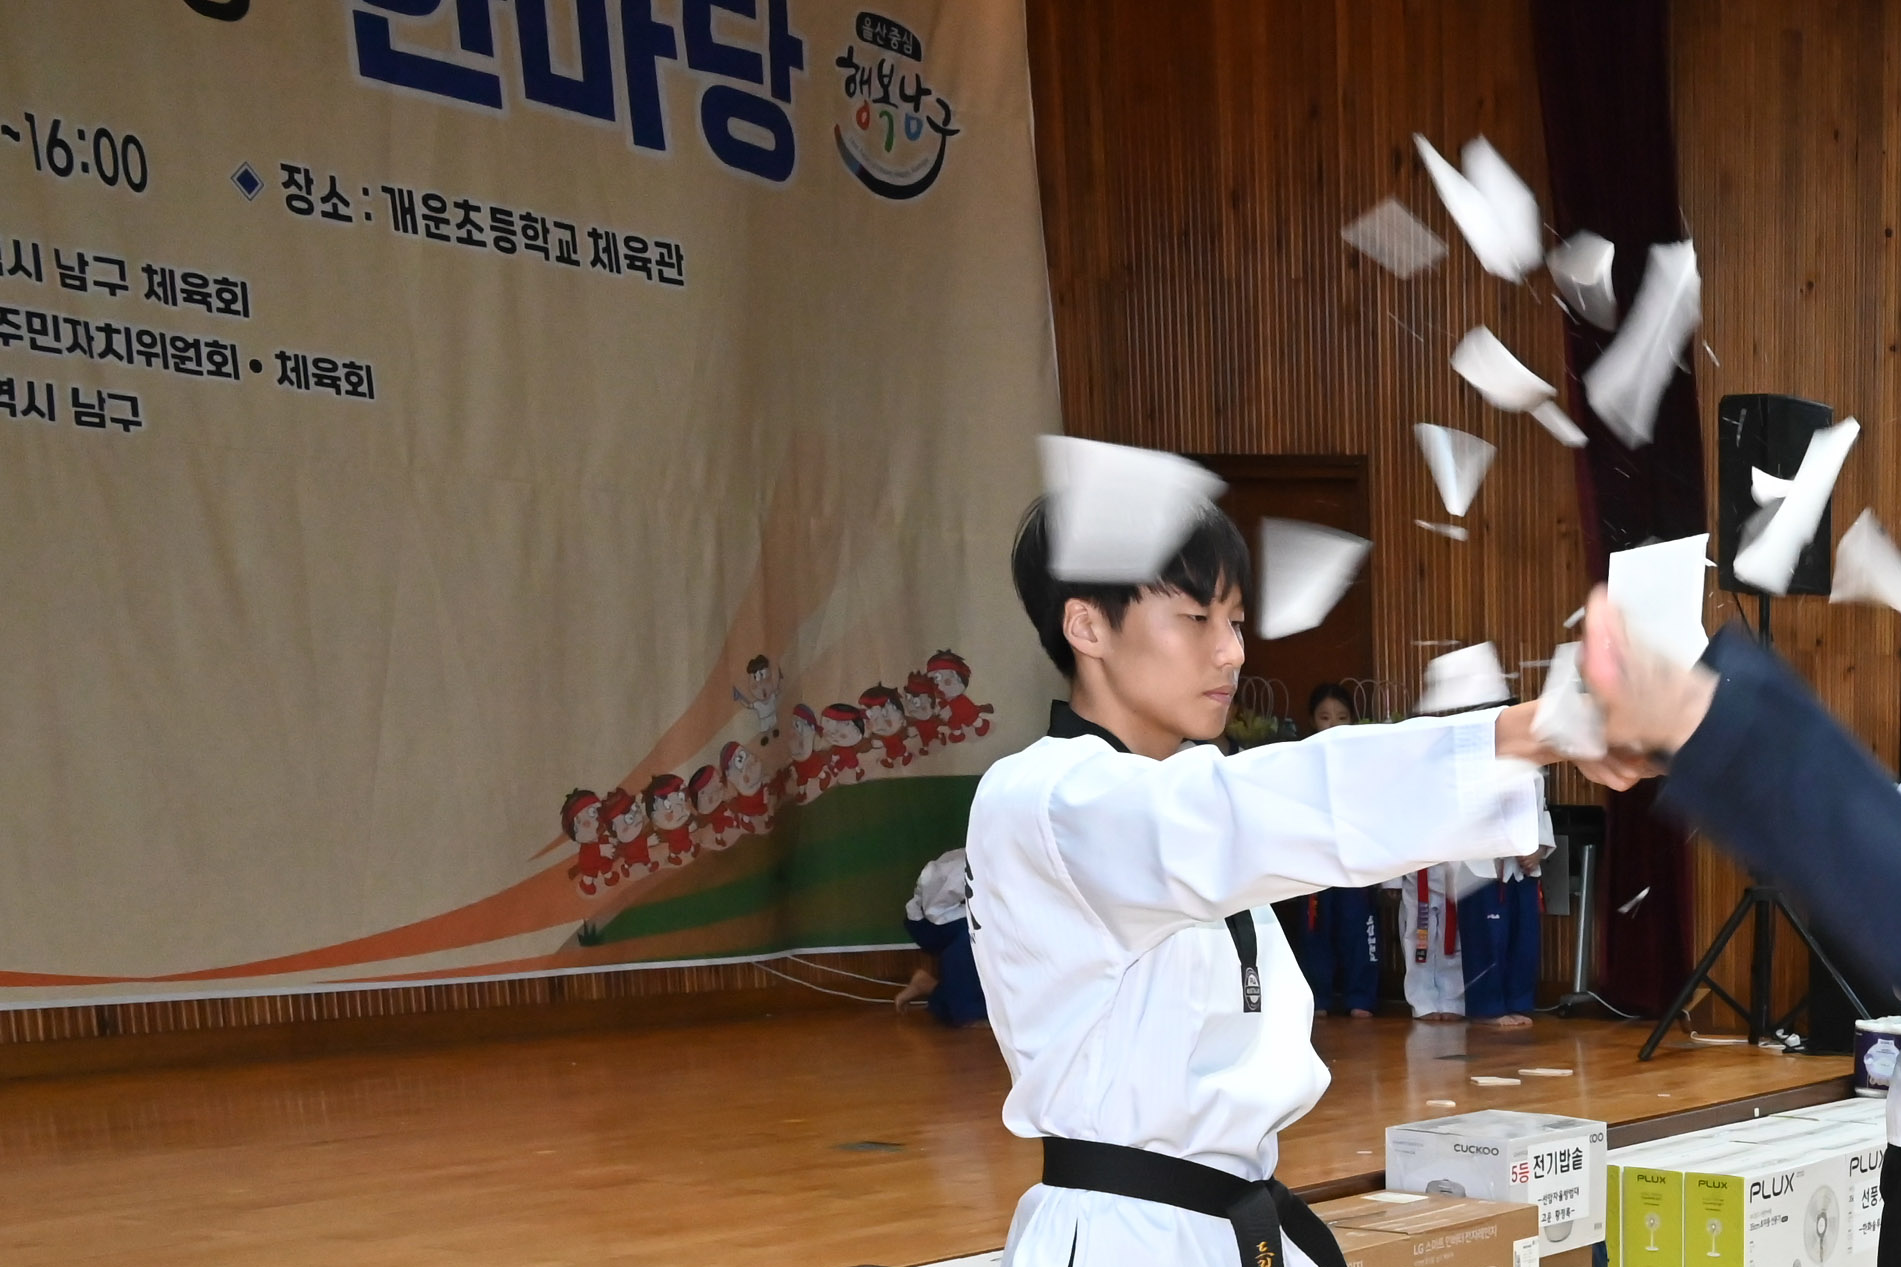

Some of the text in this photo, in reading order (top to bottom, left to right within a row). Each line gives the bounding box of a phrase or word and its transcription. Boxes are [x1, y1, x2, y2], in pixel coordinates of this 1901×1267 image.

[862, 17, 913, 54] 울산중심
[836, 45, 960, 152] 행복남구
[280, 162, 353, 224] 장소
[381, 187, 581, 271] 개운초등학교
[586, 225, 685, 287] 체육관
[0, 239, 250, 318] 시 남구 체육회
[274, 350, 376, 400] 체육회
[71, 386, 142, 431] 남구
[1453, 1144, 1500, 1156] CUCKOO
[1511, 1146, 1583, 1184] 5등 전기밥솥
[1637, 1174, 1666, 1185] PLUX
[1698, 1179, 1728, 1190] PLUX
[1750, 1172, 1795, 1204] PLUX
[1861, 1185, 1885, 1210] 선풍
[1413, 1244, 1425, 1256] LG
[1425, 1238, 1445, 1252] 스마트
[1464, 1224, 1498, 1245] 전자레인지
